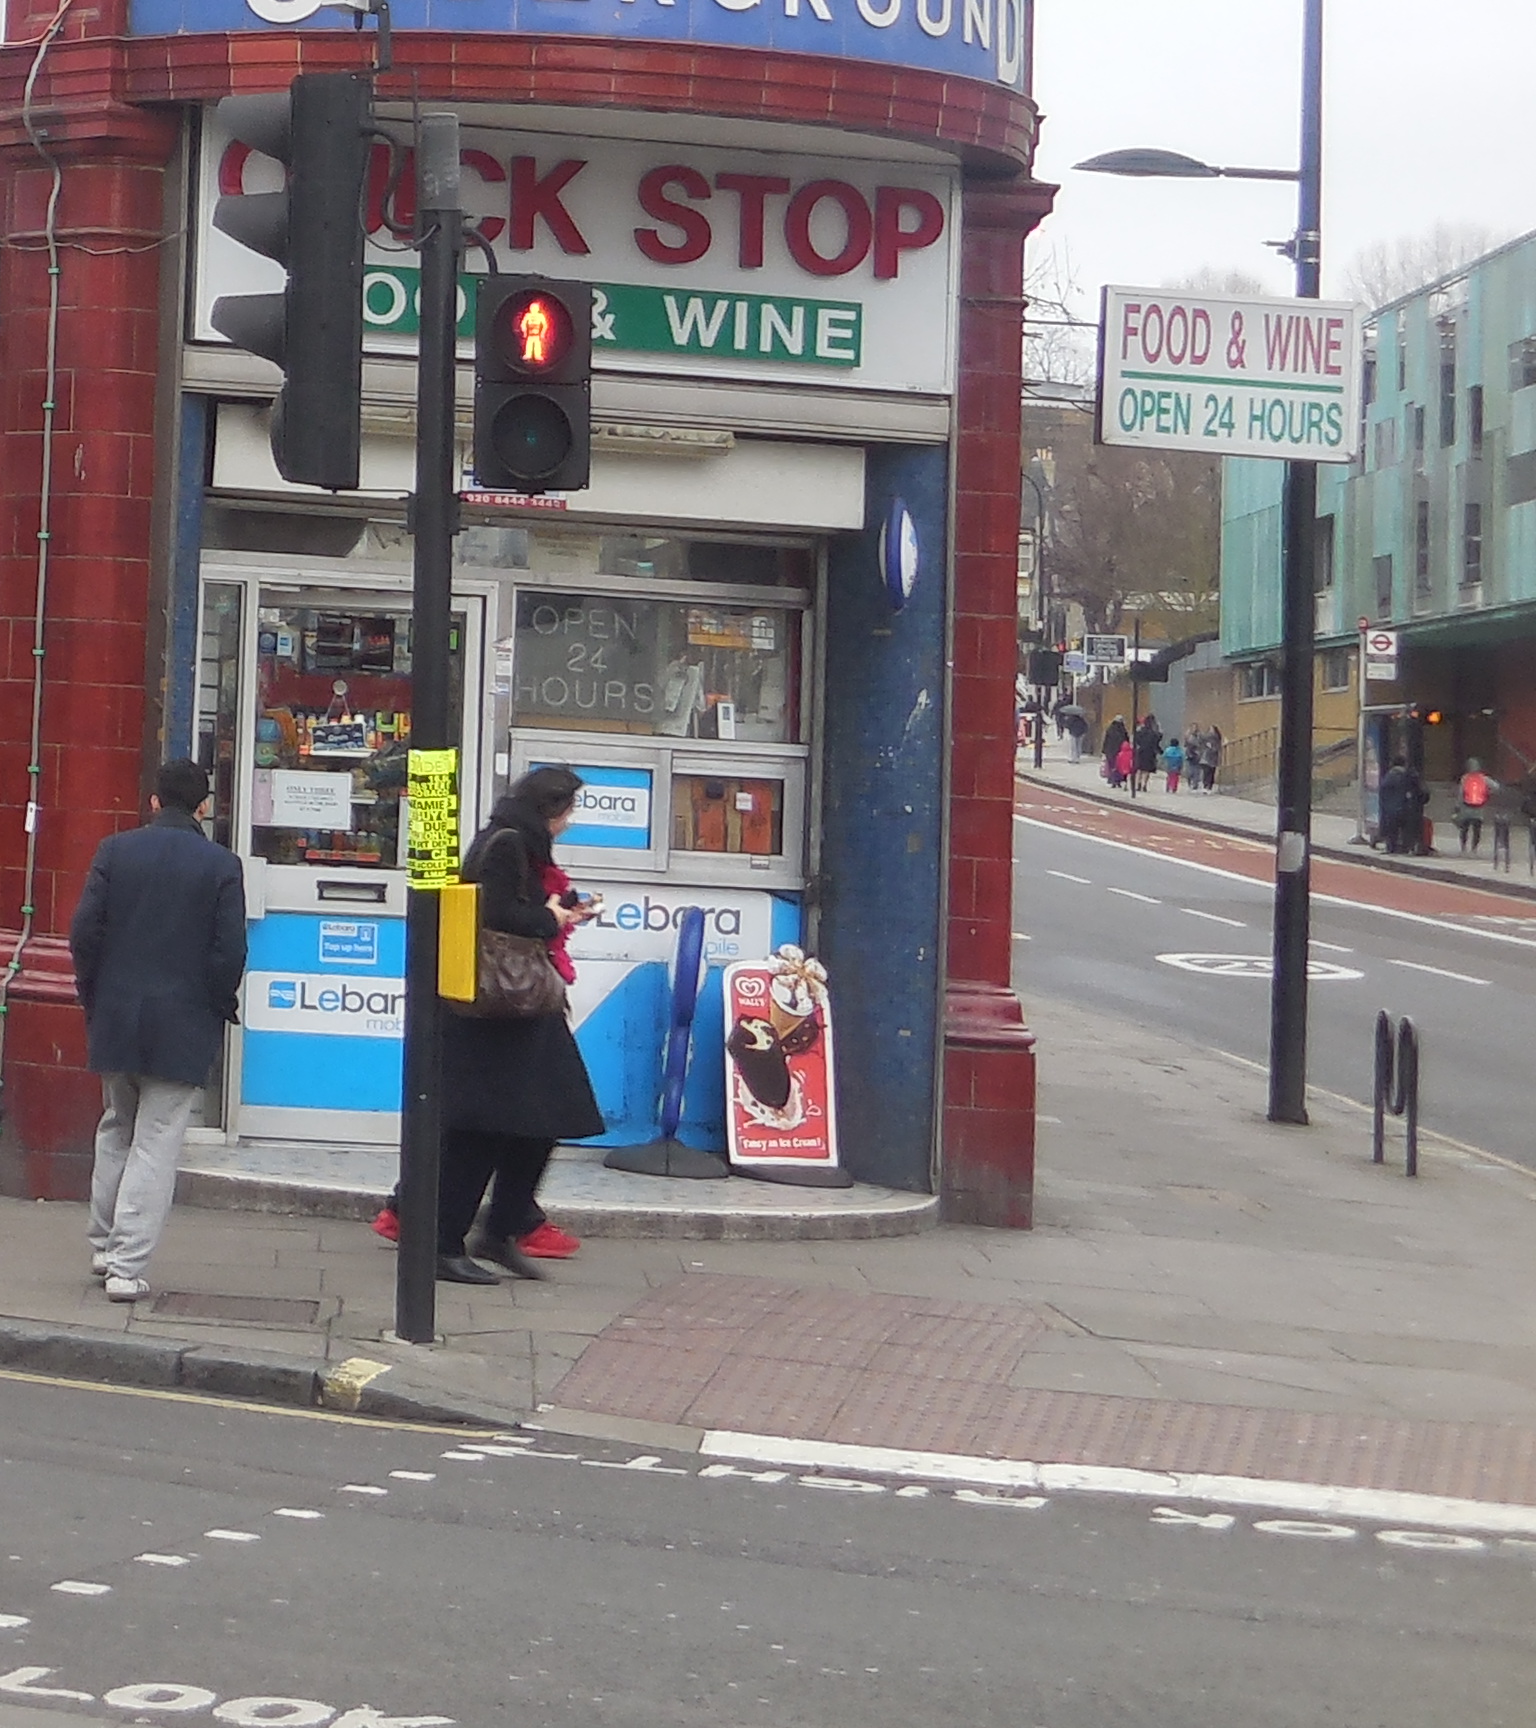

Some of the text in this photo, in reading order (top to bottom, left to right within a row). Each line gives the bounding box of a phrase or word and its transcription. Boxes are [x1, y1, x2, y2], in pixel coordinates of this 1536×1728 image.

[633, 162, 945, 280] STOP
[663, 294, 857, 361] WINE
[1121, 303, 1344, 375] FOOD & WINE
[1119, 387, 1343, 447] OPEN 24 HOURS
[532, 605, 638, 639] OPEN
[567, 643, 607, 674] 24
[515, 677, 655, 713] HOURS
[573, 790, 636, 812] ebara
[300, 981, 405, 1015] Lebar
